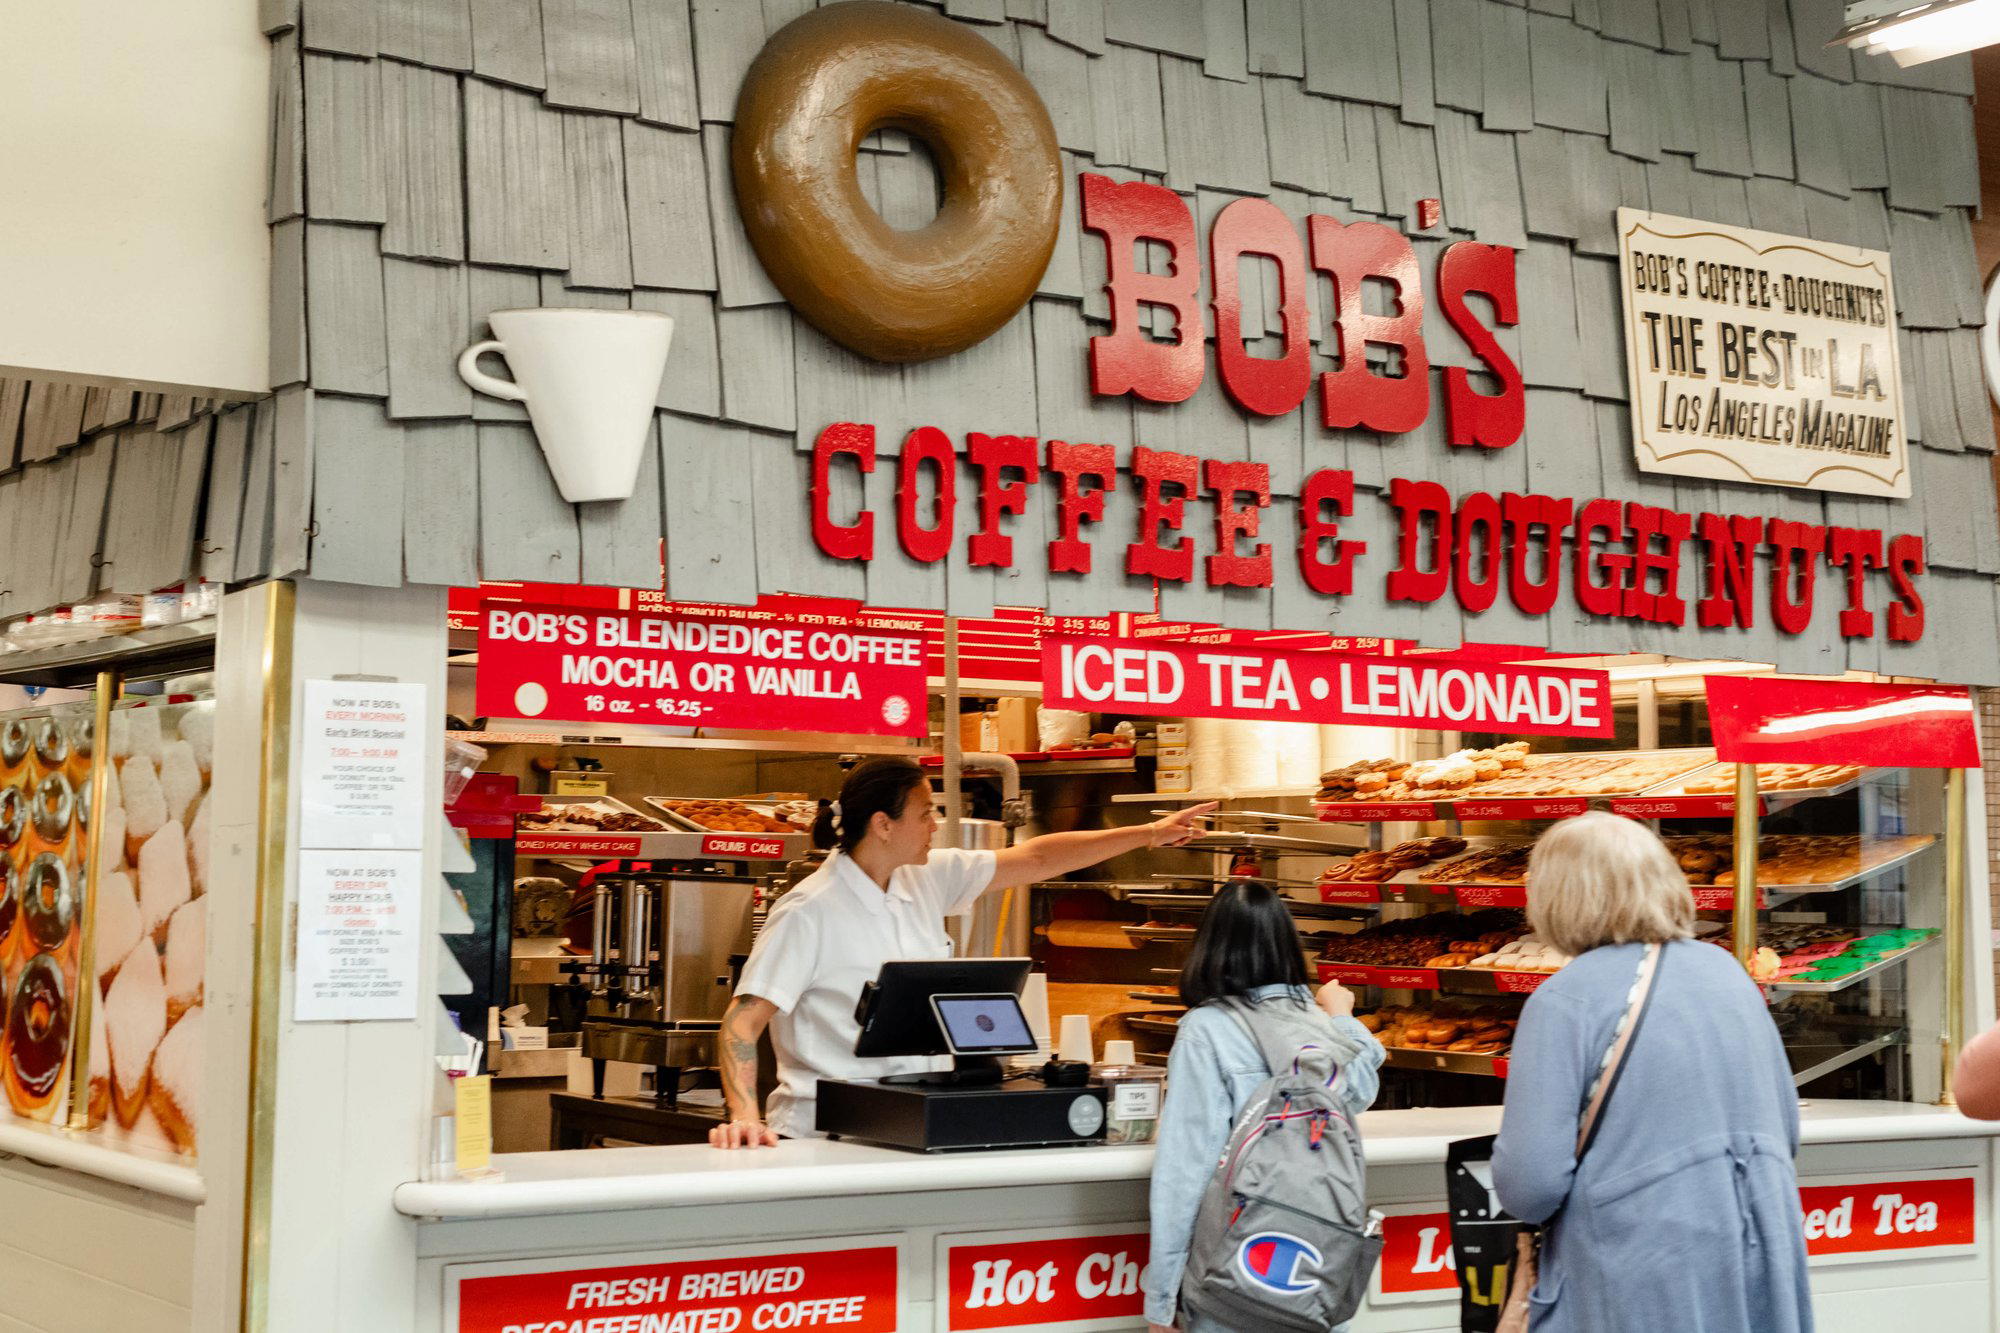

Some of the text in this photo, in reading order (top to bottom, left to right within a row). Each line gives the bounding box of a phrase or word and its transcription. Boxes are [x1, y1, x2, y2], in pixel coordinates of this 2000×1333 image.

[1633, 250, 1688, 299] BOB'S
[1695, 260, 1771, 312] COFFEE
[1079, 172, 1525, 450] BOB'S
[1640, 311, 1706, 379] THE
[1717, 320, 1797, 390] BEST
[810, 421, 1924, 643] COFFEE & DOUGHNUTS
[489, 610, 588, 646] BOB'S
[808, 631, 922, 667] COFFEE
[826, 616, 848, 626] TEA
[562, 655, 862, 700] MOCHA OR VANILLA
[1060, 644, 1600, 728] ICED TEA LEMONADE
[584, 694, 605, 711] 16
[546, 841, 579, 851] HONEY
[580, 841, 611, 851] WHEAT
[611, 842, 637, 852] CAKE
[708, 839, 780, 855] CRUMB CAKE
[1801, 1193, 1938, 1240] ed Tea
[567, 1266, 805, 1310] FRESH BREWED
[965, 1259, 1059, 1308] Hot
[751, 1296, 866, 1328] COFFEE
